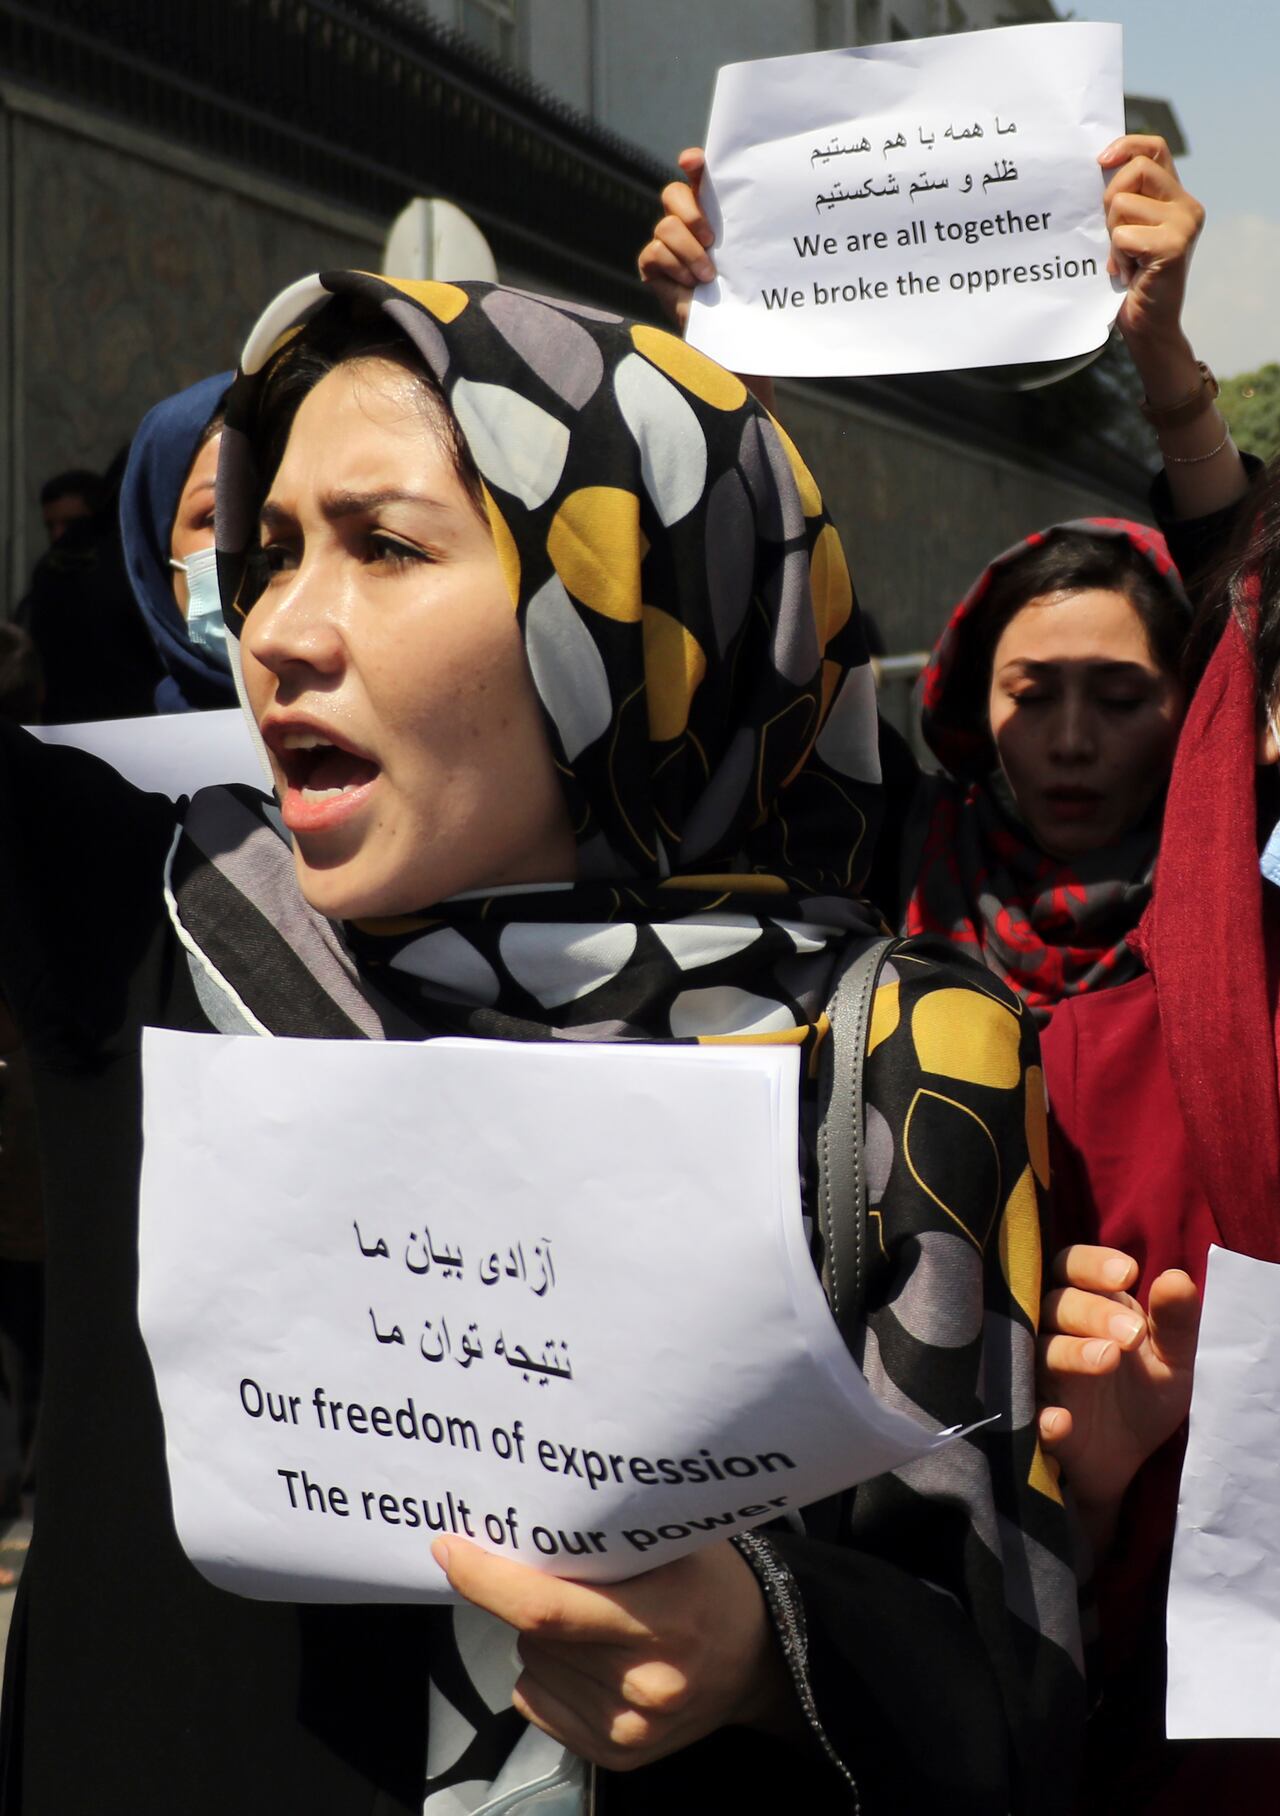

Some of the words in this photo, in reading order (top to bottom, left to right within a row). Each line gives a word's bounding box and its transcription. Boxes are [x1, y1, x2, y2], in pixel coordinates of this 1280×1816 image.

[918, 126, 935, 150] با
[943, 123, 984, 140] همه
[995, 115, 1017, 135] ما
[810, 136, 872, 169] هستیم
[882, 132, 907, 159] هم
[815, 173, 900, 215] شکستیم
[908, 171, 949, 202] ستم
[959, 173, 973, 193] و
[981, 158, 1019, 194] ظلم
[792, 233, 838, 258] We
[846, 231, 888, 253] are
[896, 219, 927, 247] all
[933, 209, 1052, 245] together
[760, 287, 805, 311] We
[813, 276, 889, 306] broke
[896, 271, 940, 296] the
[949, 255, 1097, 294] oppression
[353, 1220, 391, 1259] ما
[405, 1225, 464, 1280] بیان
[479, 1237, 556, 1297] آزادی
[368, 1306, 406, 1346] ما
[419, 1315, 484, 1369] توان
[493, 1330, 573, 1387] نتیجه
[239, 1377, 302, 1425] Our
[311, 1387, 482, 1452] freedom
[491, 1419, 526, 1464] of
[537, 1439, 797, 1491] expression
[276, 1468, 350, 1517] The
[360, 1488, 476, 1538] result
[484, 1506, 520, 1550] of
[531, 1525, 608, 1556] our
[620, 1495, 788, 1553] power
